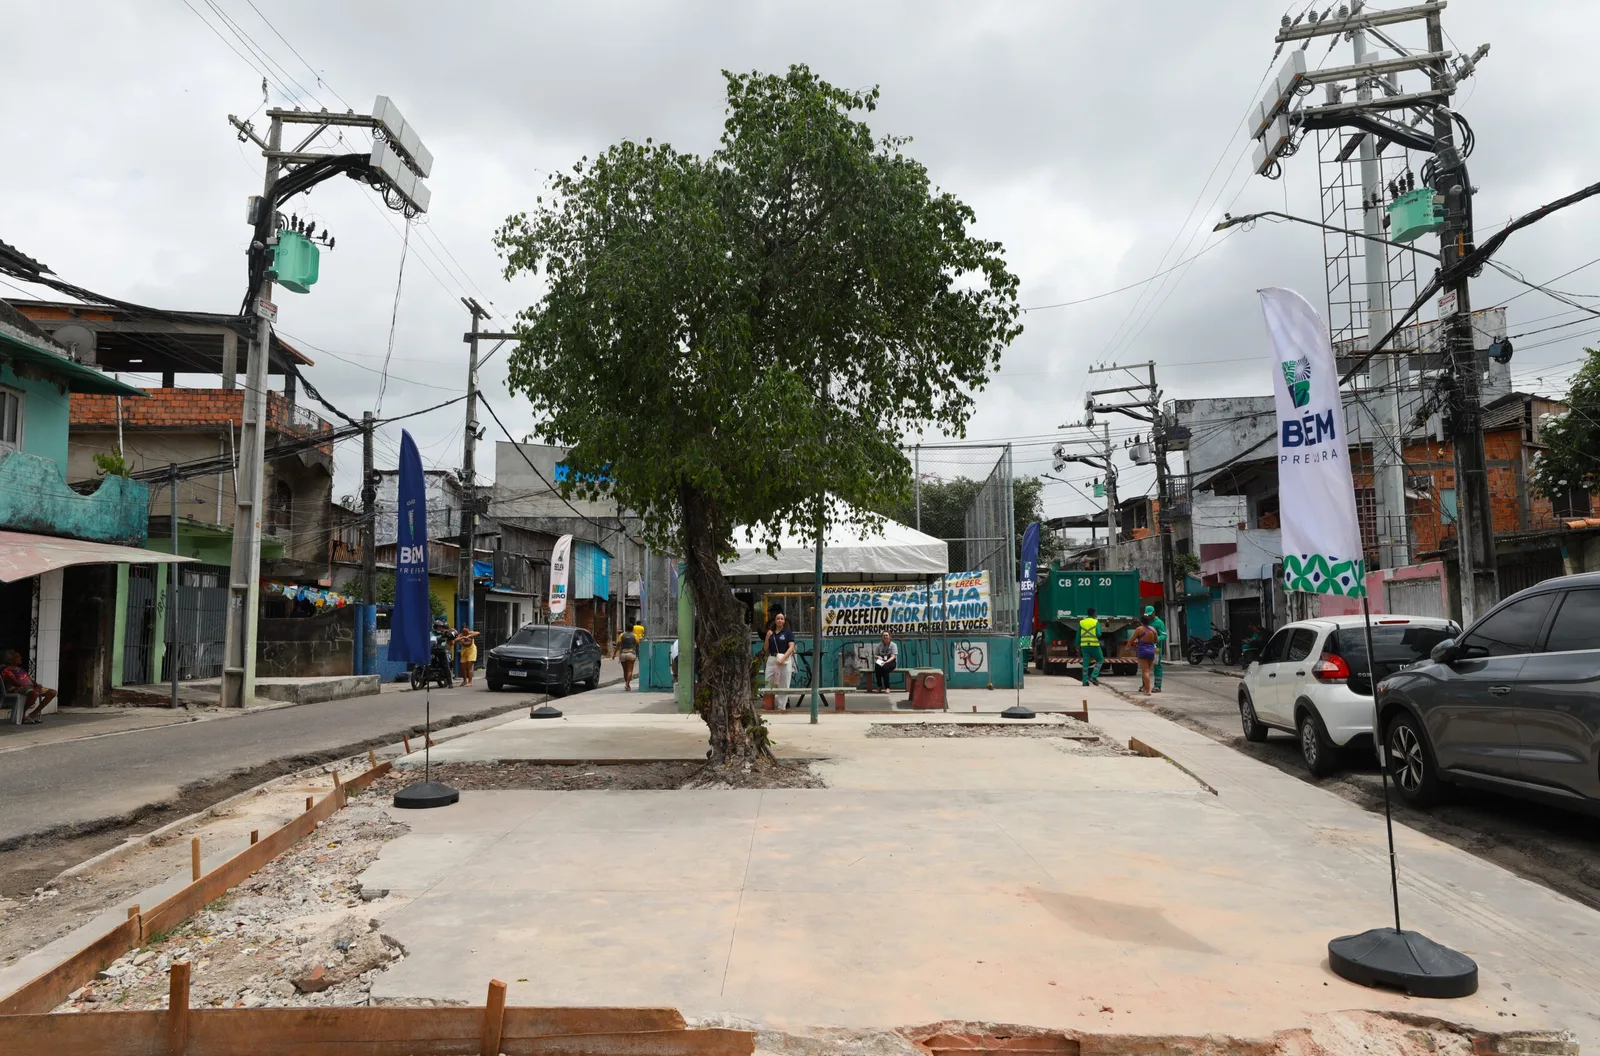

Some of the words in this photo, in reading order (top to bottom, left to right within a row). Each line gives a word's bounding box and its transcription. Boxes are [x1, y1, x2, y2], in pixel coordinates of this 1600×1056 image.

[955, 579, 982, 588] LAZER
[1058, 578, 1072, 587] CB
[1078, 577, 1091, 586] 20
[1099, 577, 1112, 586] 20
[888, 587, 980, 606] MARTHA
[836, 607, 889, 625] PREFEITO
[890, 606, 920, 623] IGOR
[826, 625, 847, 636] PELO
[847, 624, 904, 636] COMPROMISSO
